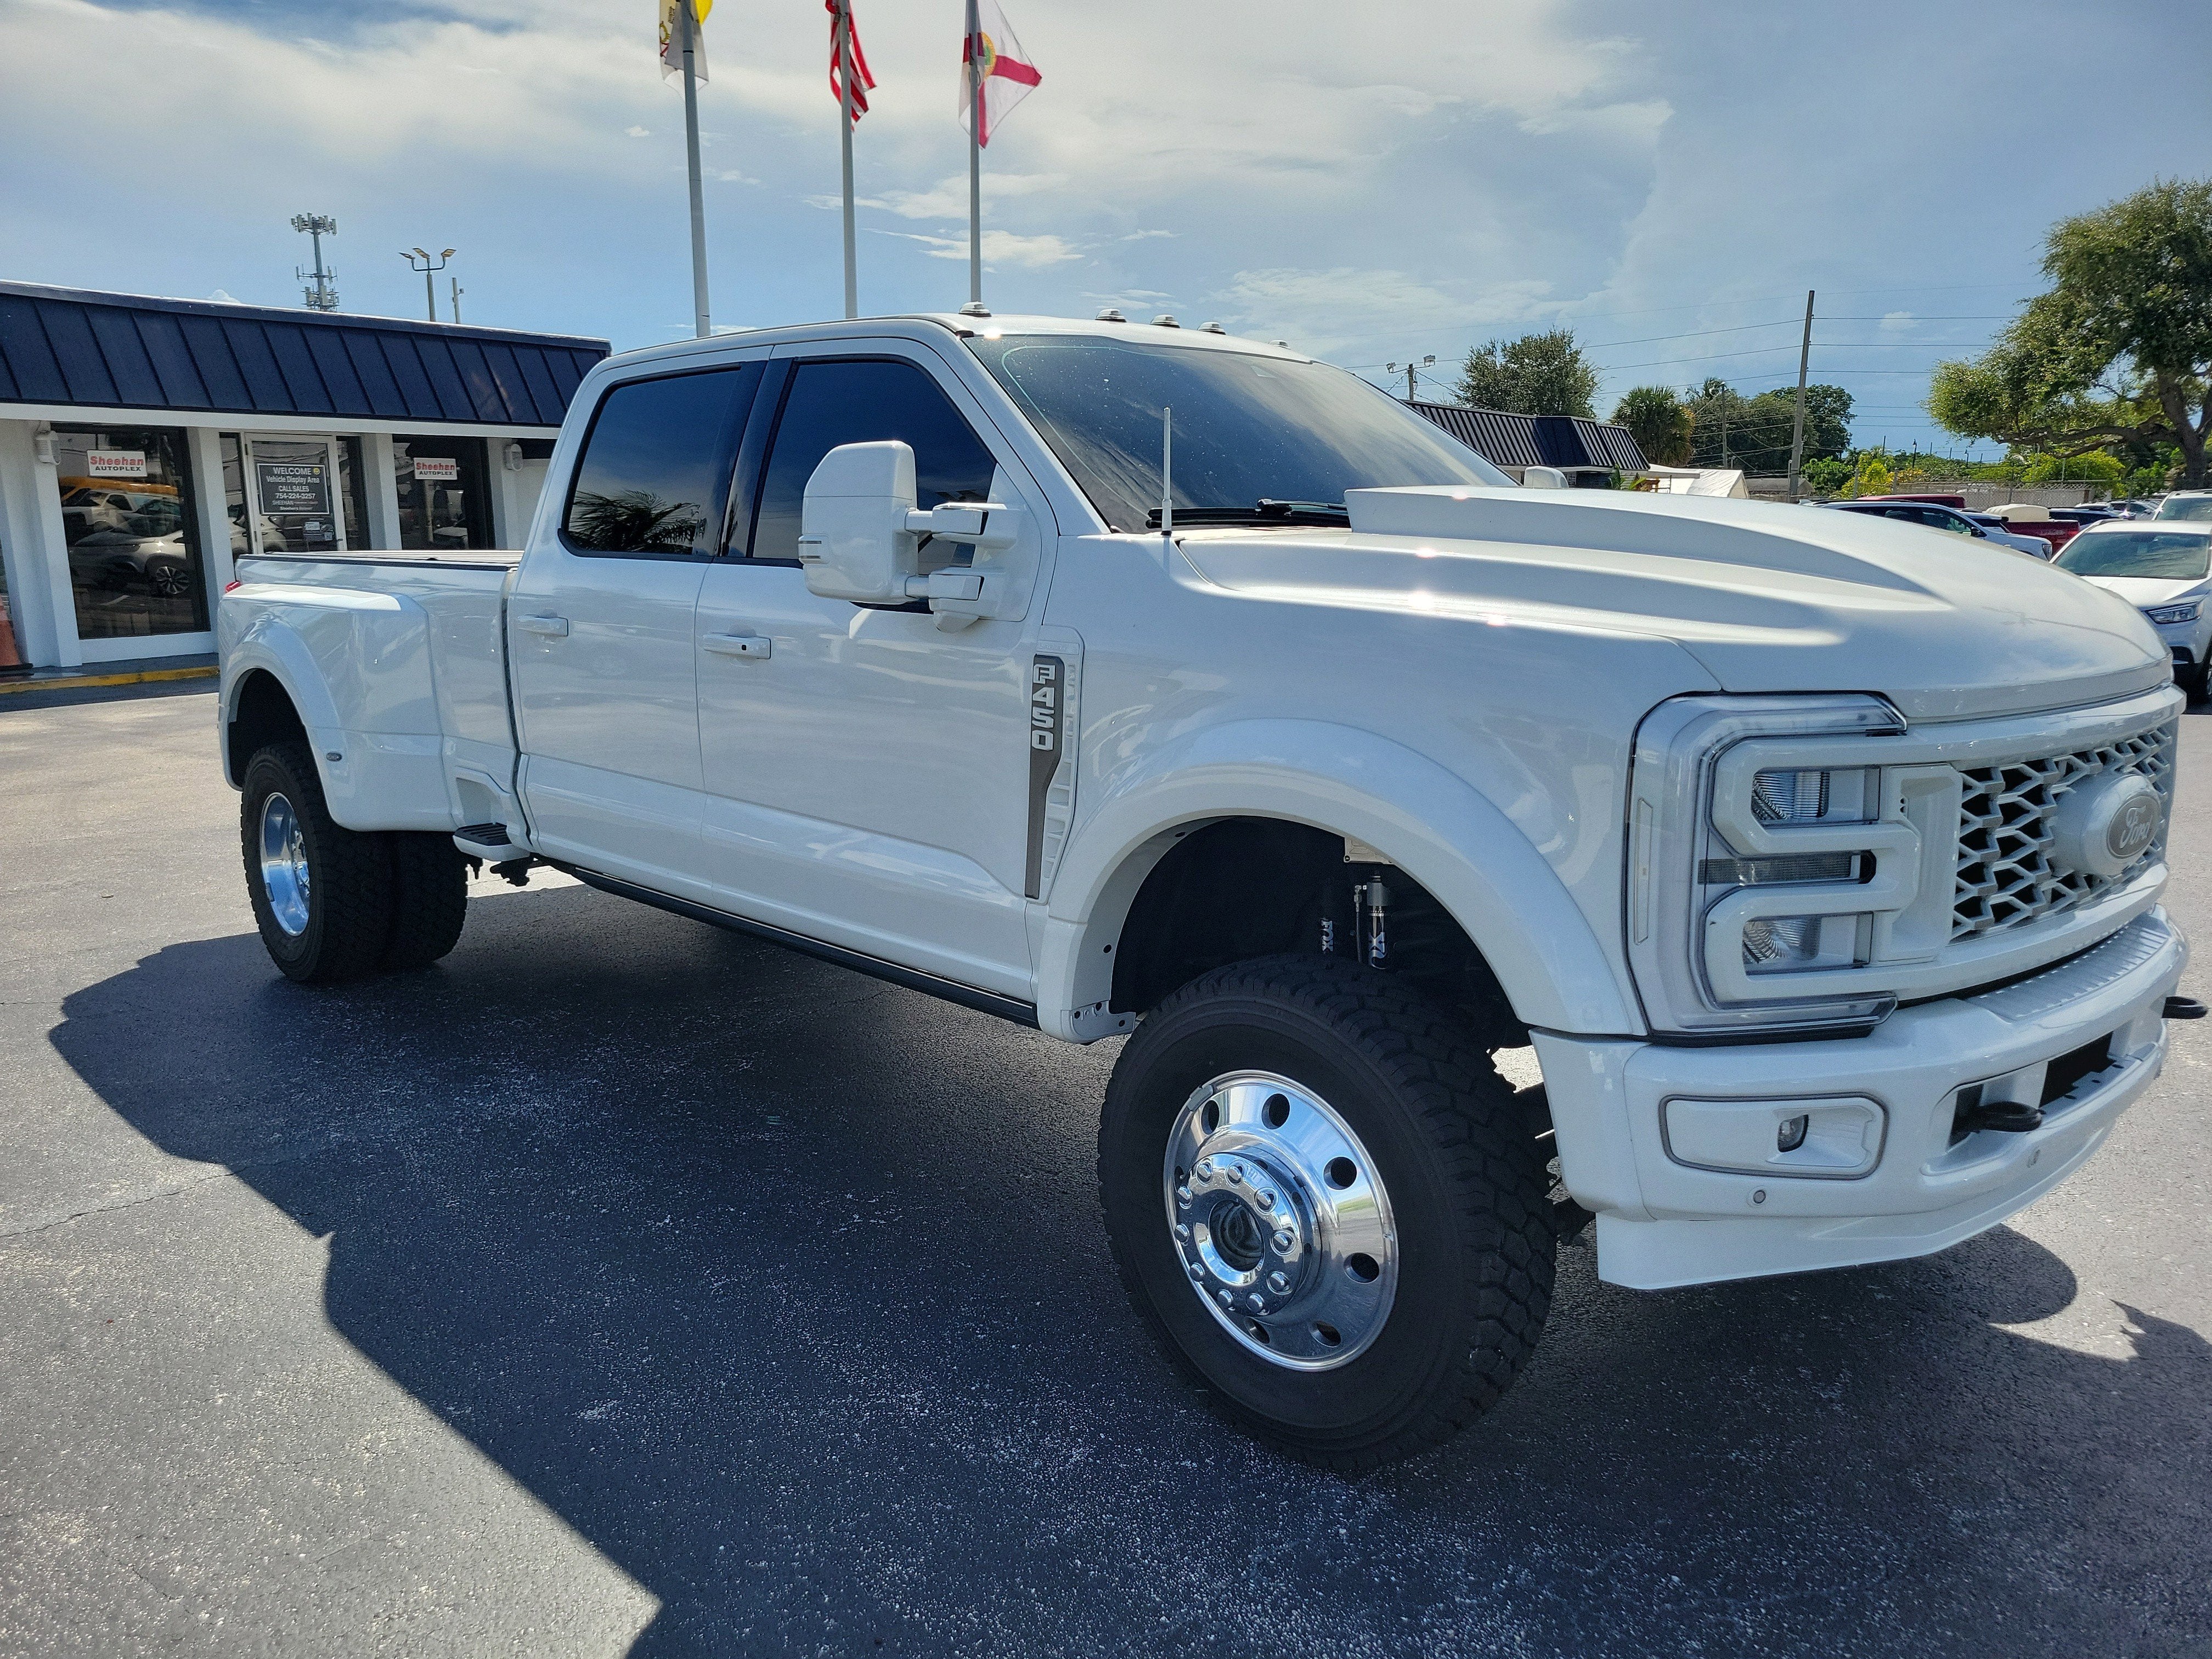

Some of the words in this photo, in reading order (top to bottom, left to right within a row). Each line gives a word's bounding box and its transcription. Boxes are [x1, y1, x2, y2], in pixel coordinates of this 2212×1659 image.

[90, 456, 144, 465] Sheehan
[287, 476, 307, 484] Display
[2119, 805, 2153, 849] Ford
[1321, 920, 1334, 952] FOX
